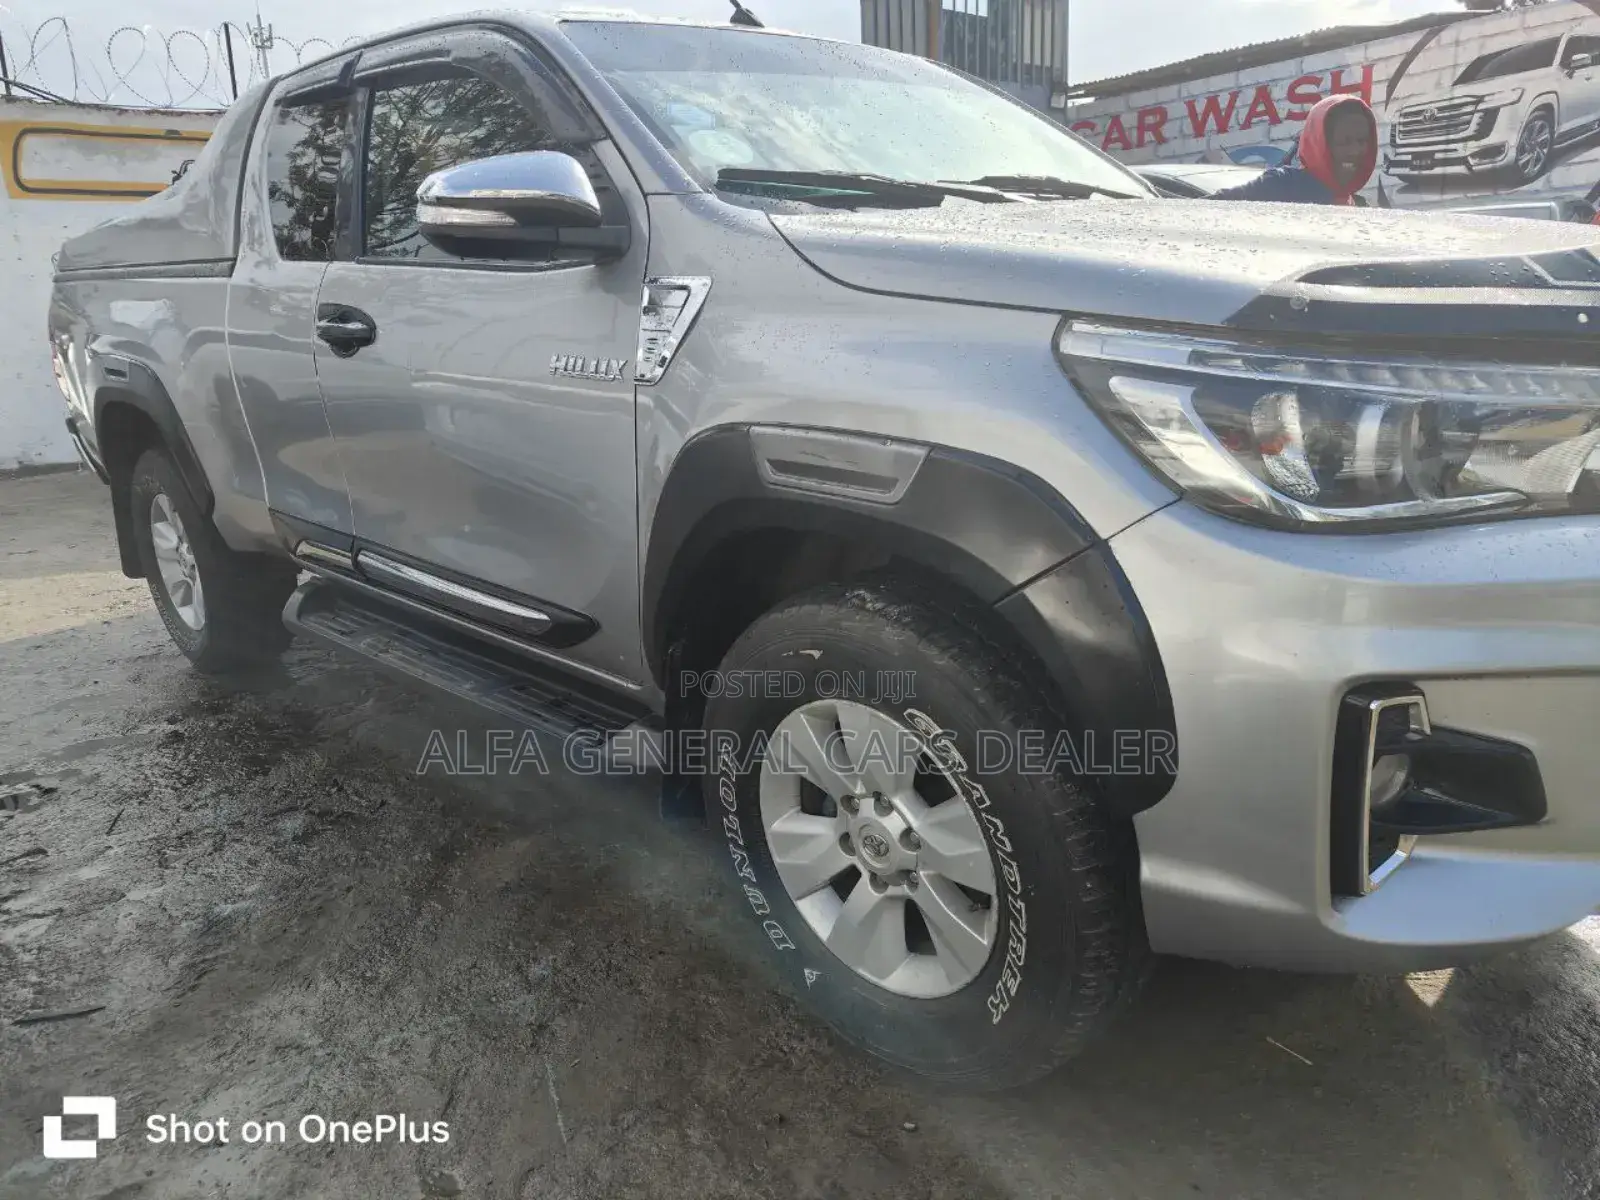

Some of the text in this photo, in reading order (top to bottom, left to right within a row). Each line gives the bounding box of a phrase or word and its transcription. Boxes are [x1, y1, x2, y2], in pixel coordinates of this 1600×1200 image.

[1184, 64, 1375, 139] WASH
[549, 352, 628, 382] HILUX
[719, 742, 796, 950] DUNLOP
[903, 708, 1026, 1024] GRANDTREK
